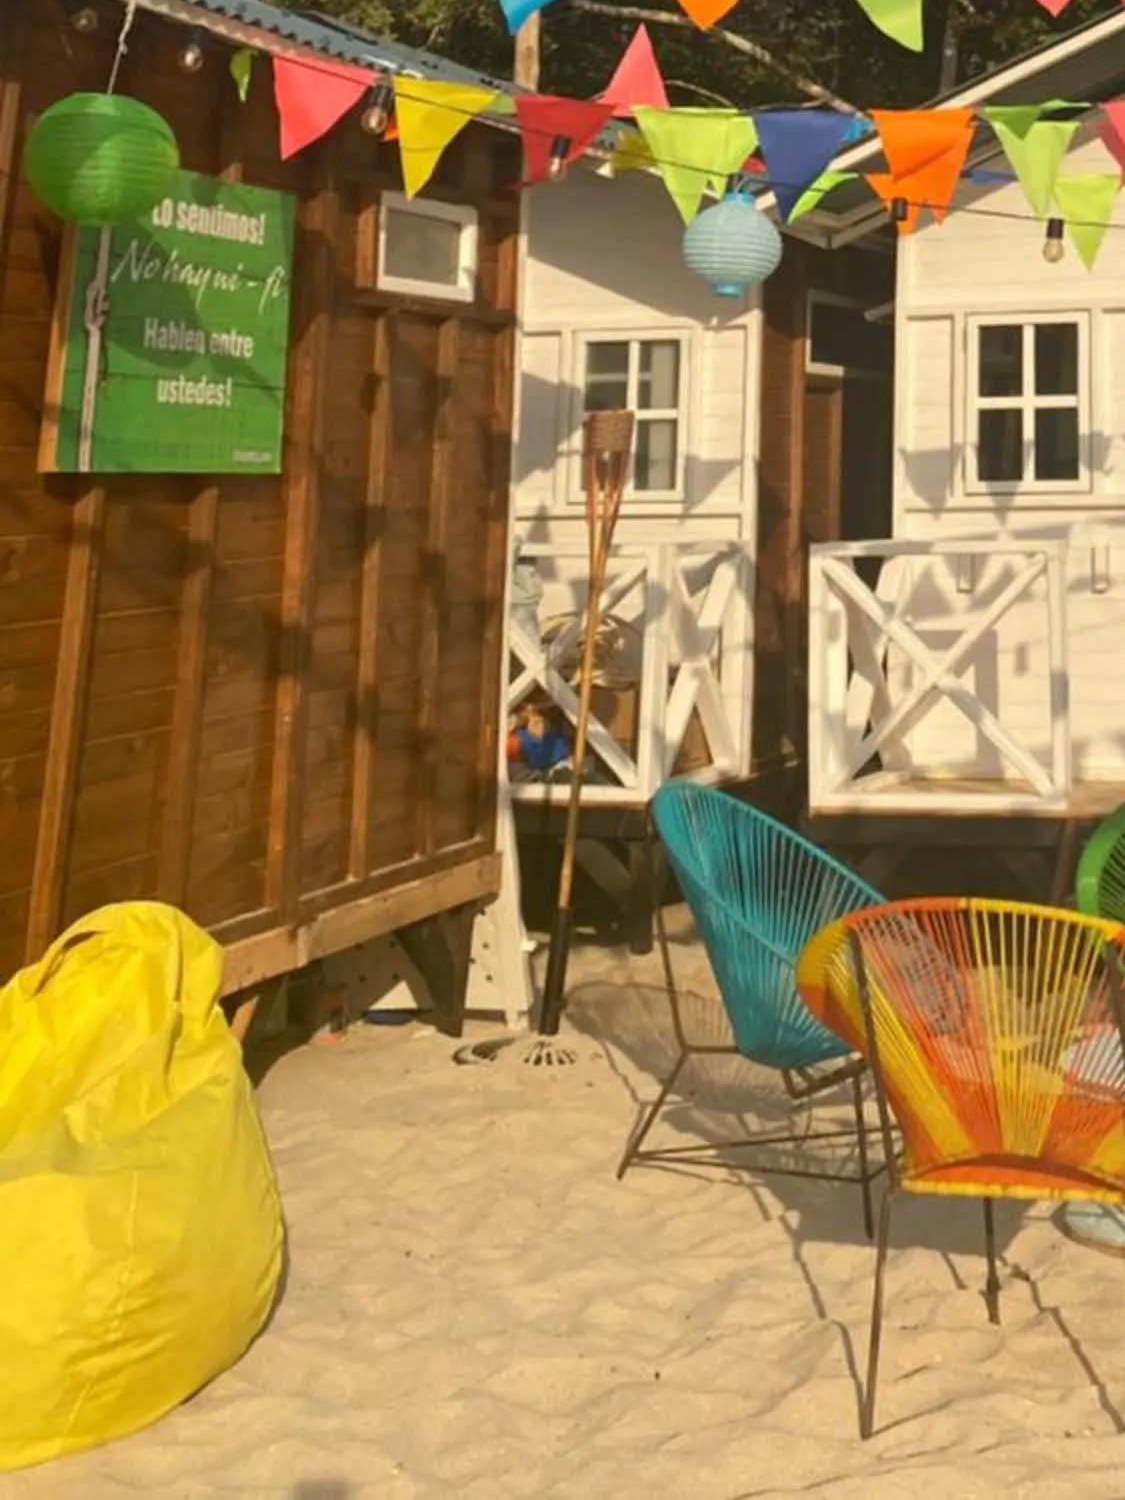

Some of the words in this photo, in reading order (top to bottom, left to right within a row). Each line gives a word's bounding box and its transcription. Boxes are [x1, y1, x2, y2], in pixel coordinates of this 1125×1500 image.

[176, 201, 265, 245] sentimos!
[111, 238, 161, 282] No
[162, 249, 212, 310] hay
[143, 317, 205, 355] Hablen
[209, 328, 254, 358] entre
[157, 372, 232, 407] ustedes!
